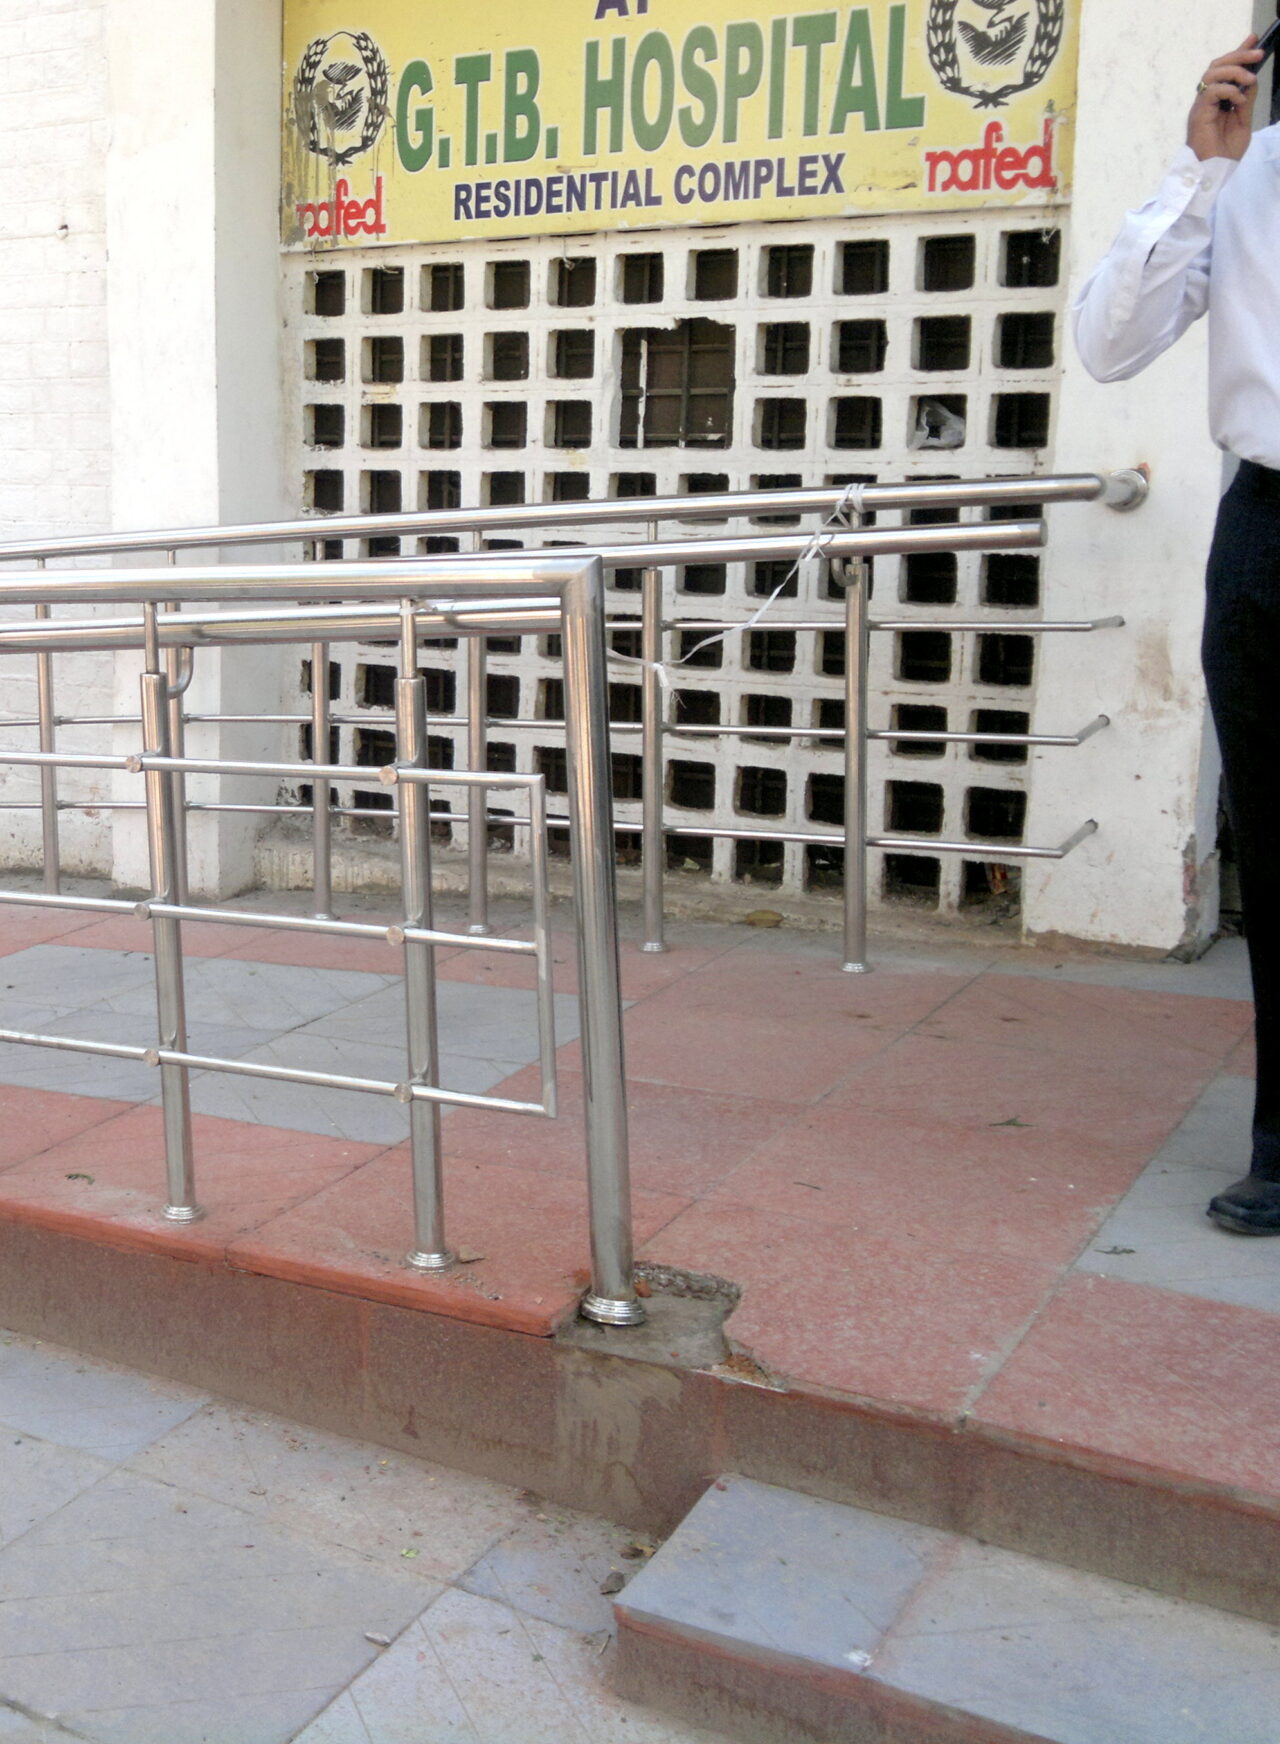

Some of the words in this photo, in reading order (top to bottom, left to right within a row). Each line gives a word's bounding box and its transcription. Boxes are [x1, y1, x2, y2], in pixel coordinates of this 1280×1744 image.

[396, 48, 559, 173] G.T.B.
[583, 4, 925, 155] HOSPITAL
[454, 168, 663, 220] RESIDENTIAL
[674, 153, 846, 204] COMPLEX
[925, 118, 1057, 192] nafed
[295, 176, 387, 237] nafed
